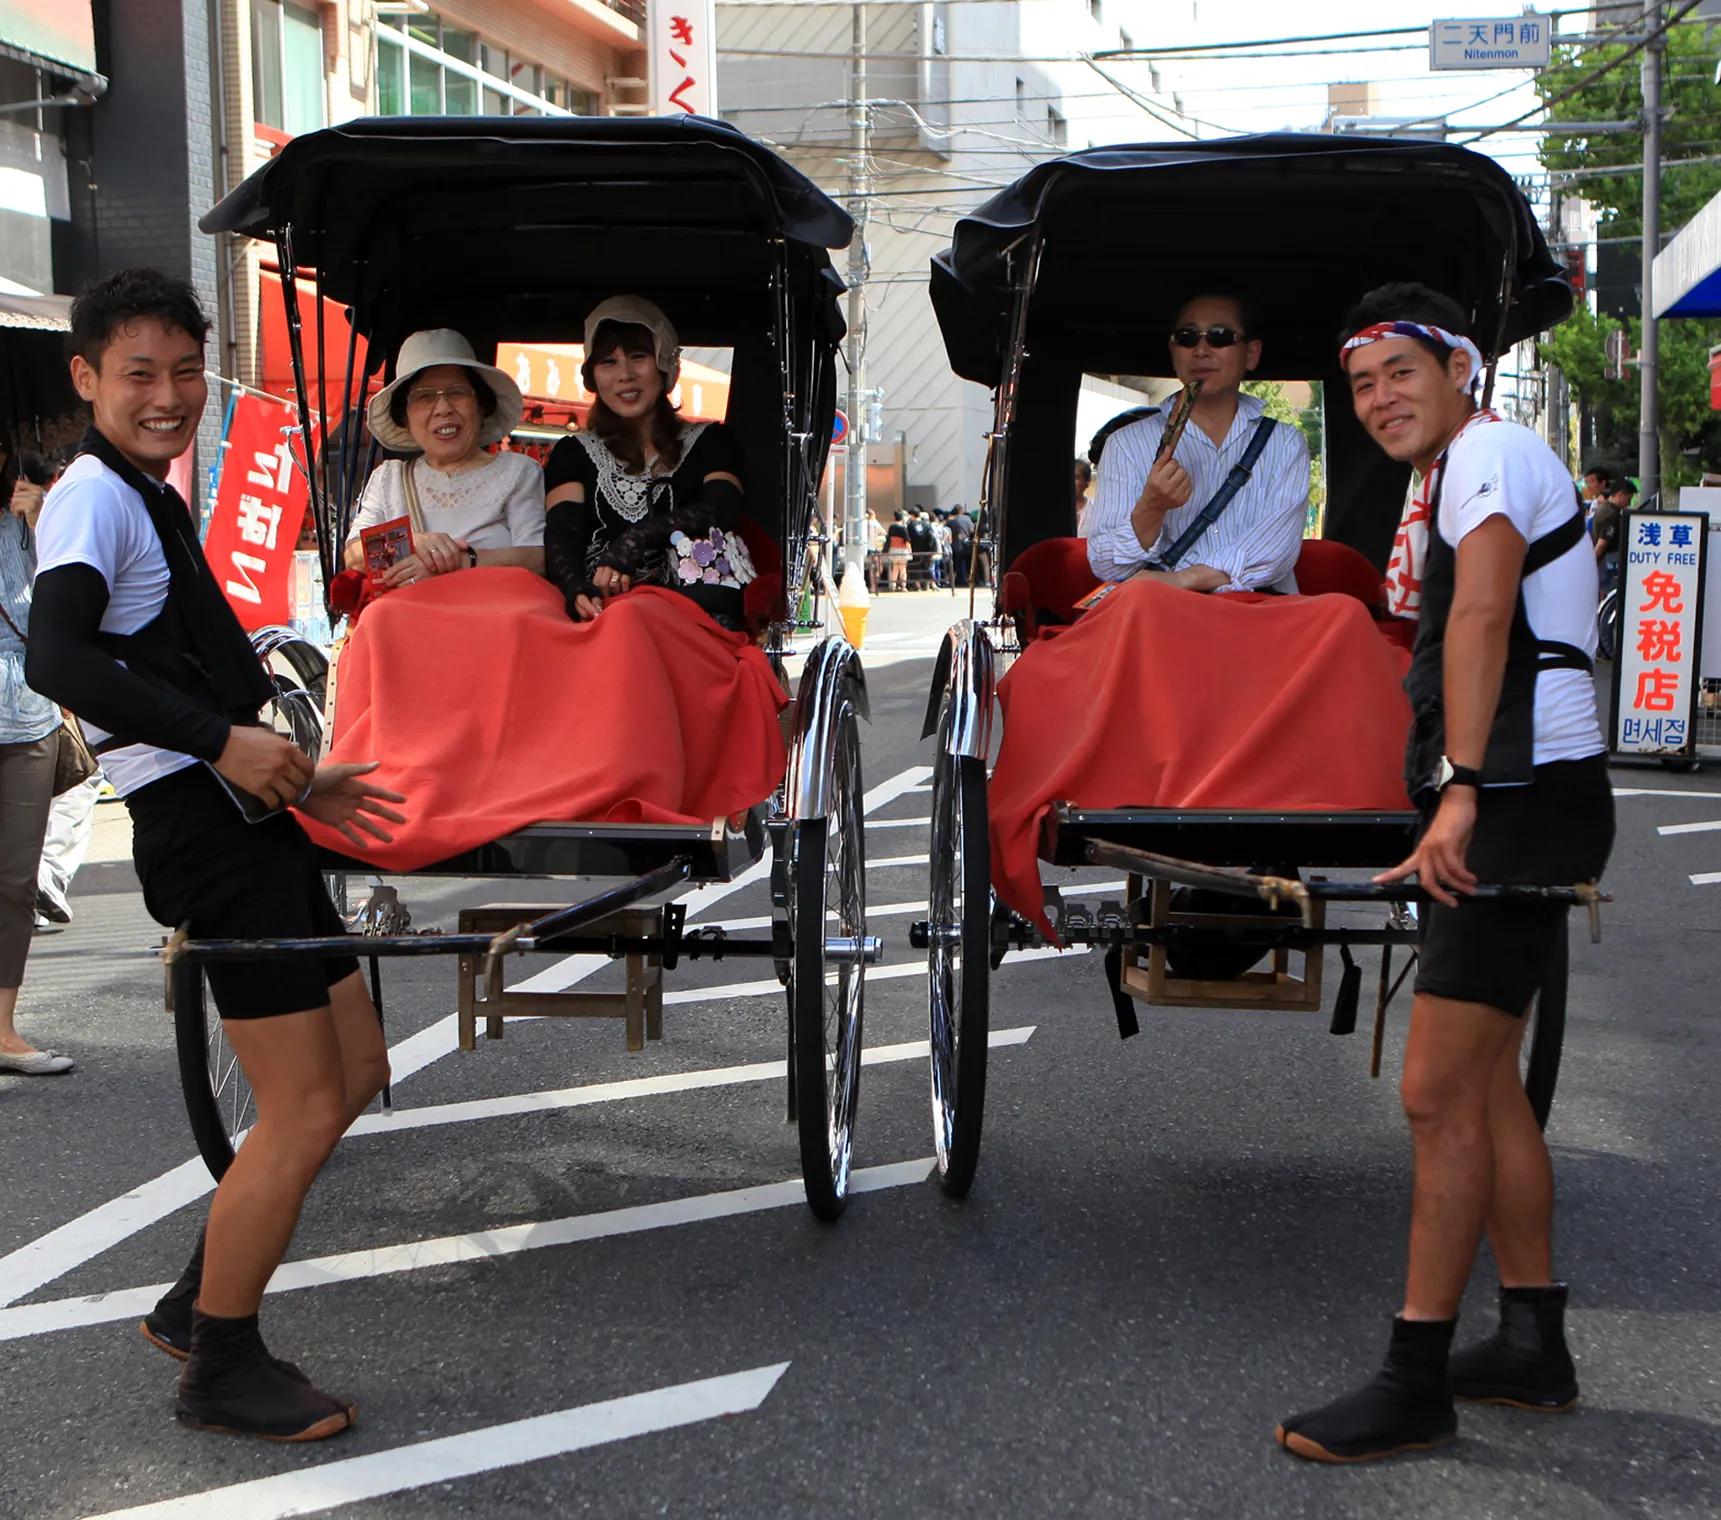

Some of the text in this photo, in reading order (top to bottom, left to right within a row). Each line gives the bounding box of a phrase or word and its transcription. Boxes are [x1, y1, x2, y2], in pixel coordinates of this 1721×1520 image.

[1443, 22, 1540, 45] 二天門前
[1464, 48, 1519, 60] Nitenmon
[1638, 522, 1693, 548] 浅草
[1629, 551, 1696, 565] DUTY FREE
[1633, 570, 1684, 712] 免税店
[1622, 717, 1685, 746] 면세점
